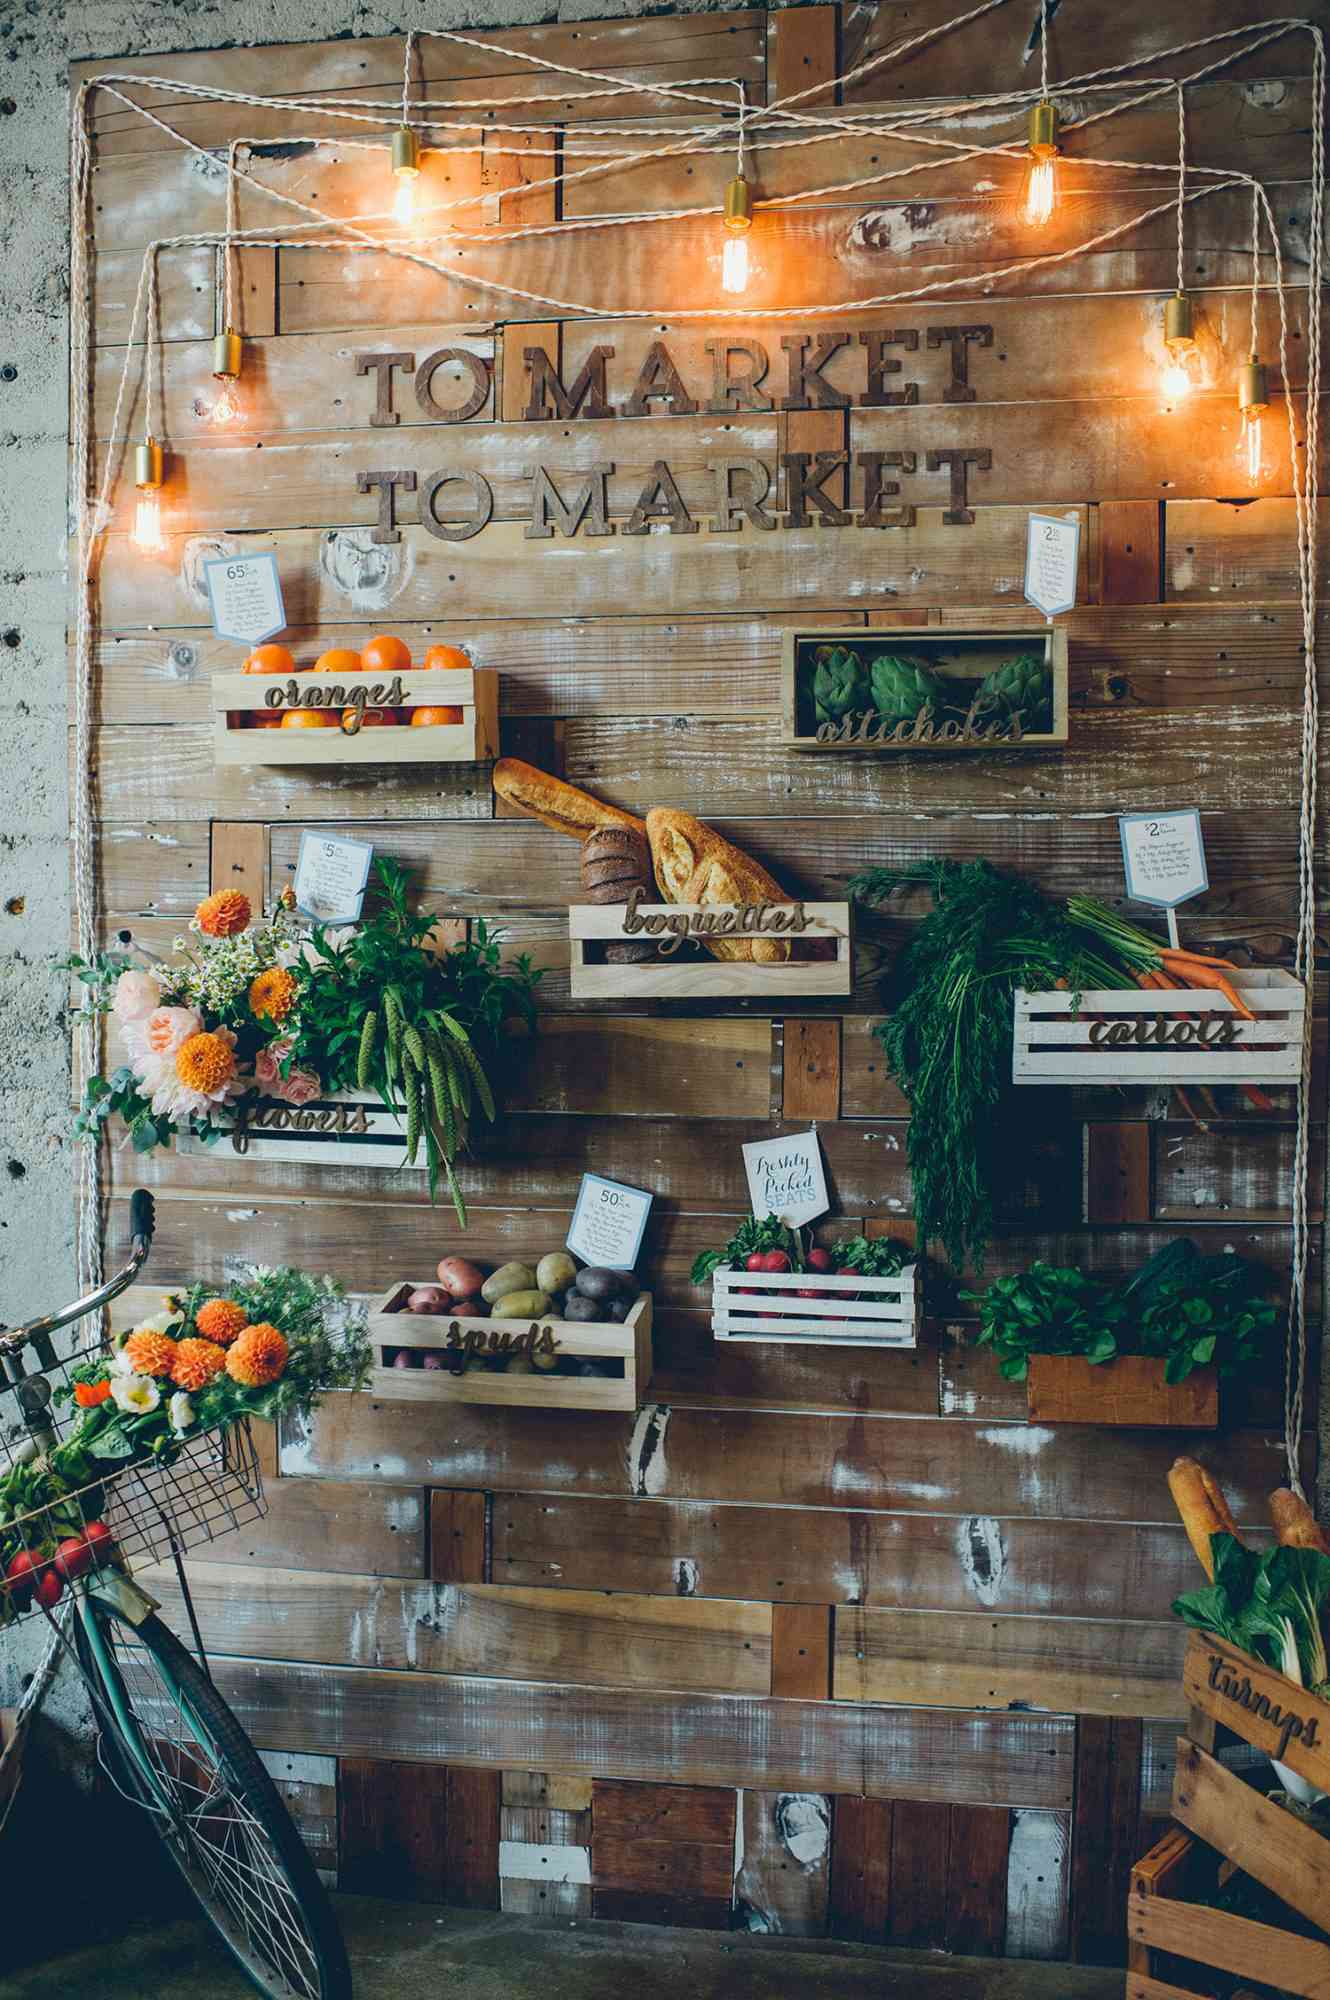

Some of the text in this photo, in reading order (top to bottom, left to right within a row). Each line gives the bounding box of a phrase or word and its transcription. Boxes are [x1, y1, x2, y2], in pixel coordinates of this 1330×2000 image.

[354, 324, 994, 425] TO MARKET
[357, 447, 993, 544] TO MARKET
[264, 676, 411, 736] oranges
[816, 688, 1031, 743] artichokes
[622, 886, 815, 955] baguettes
[1088, 1009, 1244, 1044] carrots
[756, 1152, 809, 1178] Freshly
[764, 1172, 812, 1201] Picked
[766, 1187, 817, 1209] SEATS
[446, 1320, 561, 1377] spuds
[1208, 1655, 1322, 1760] turnips
